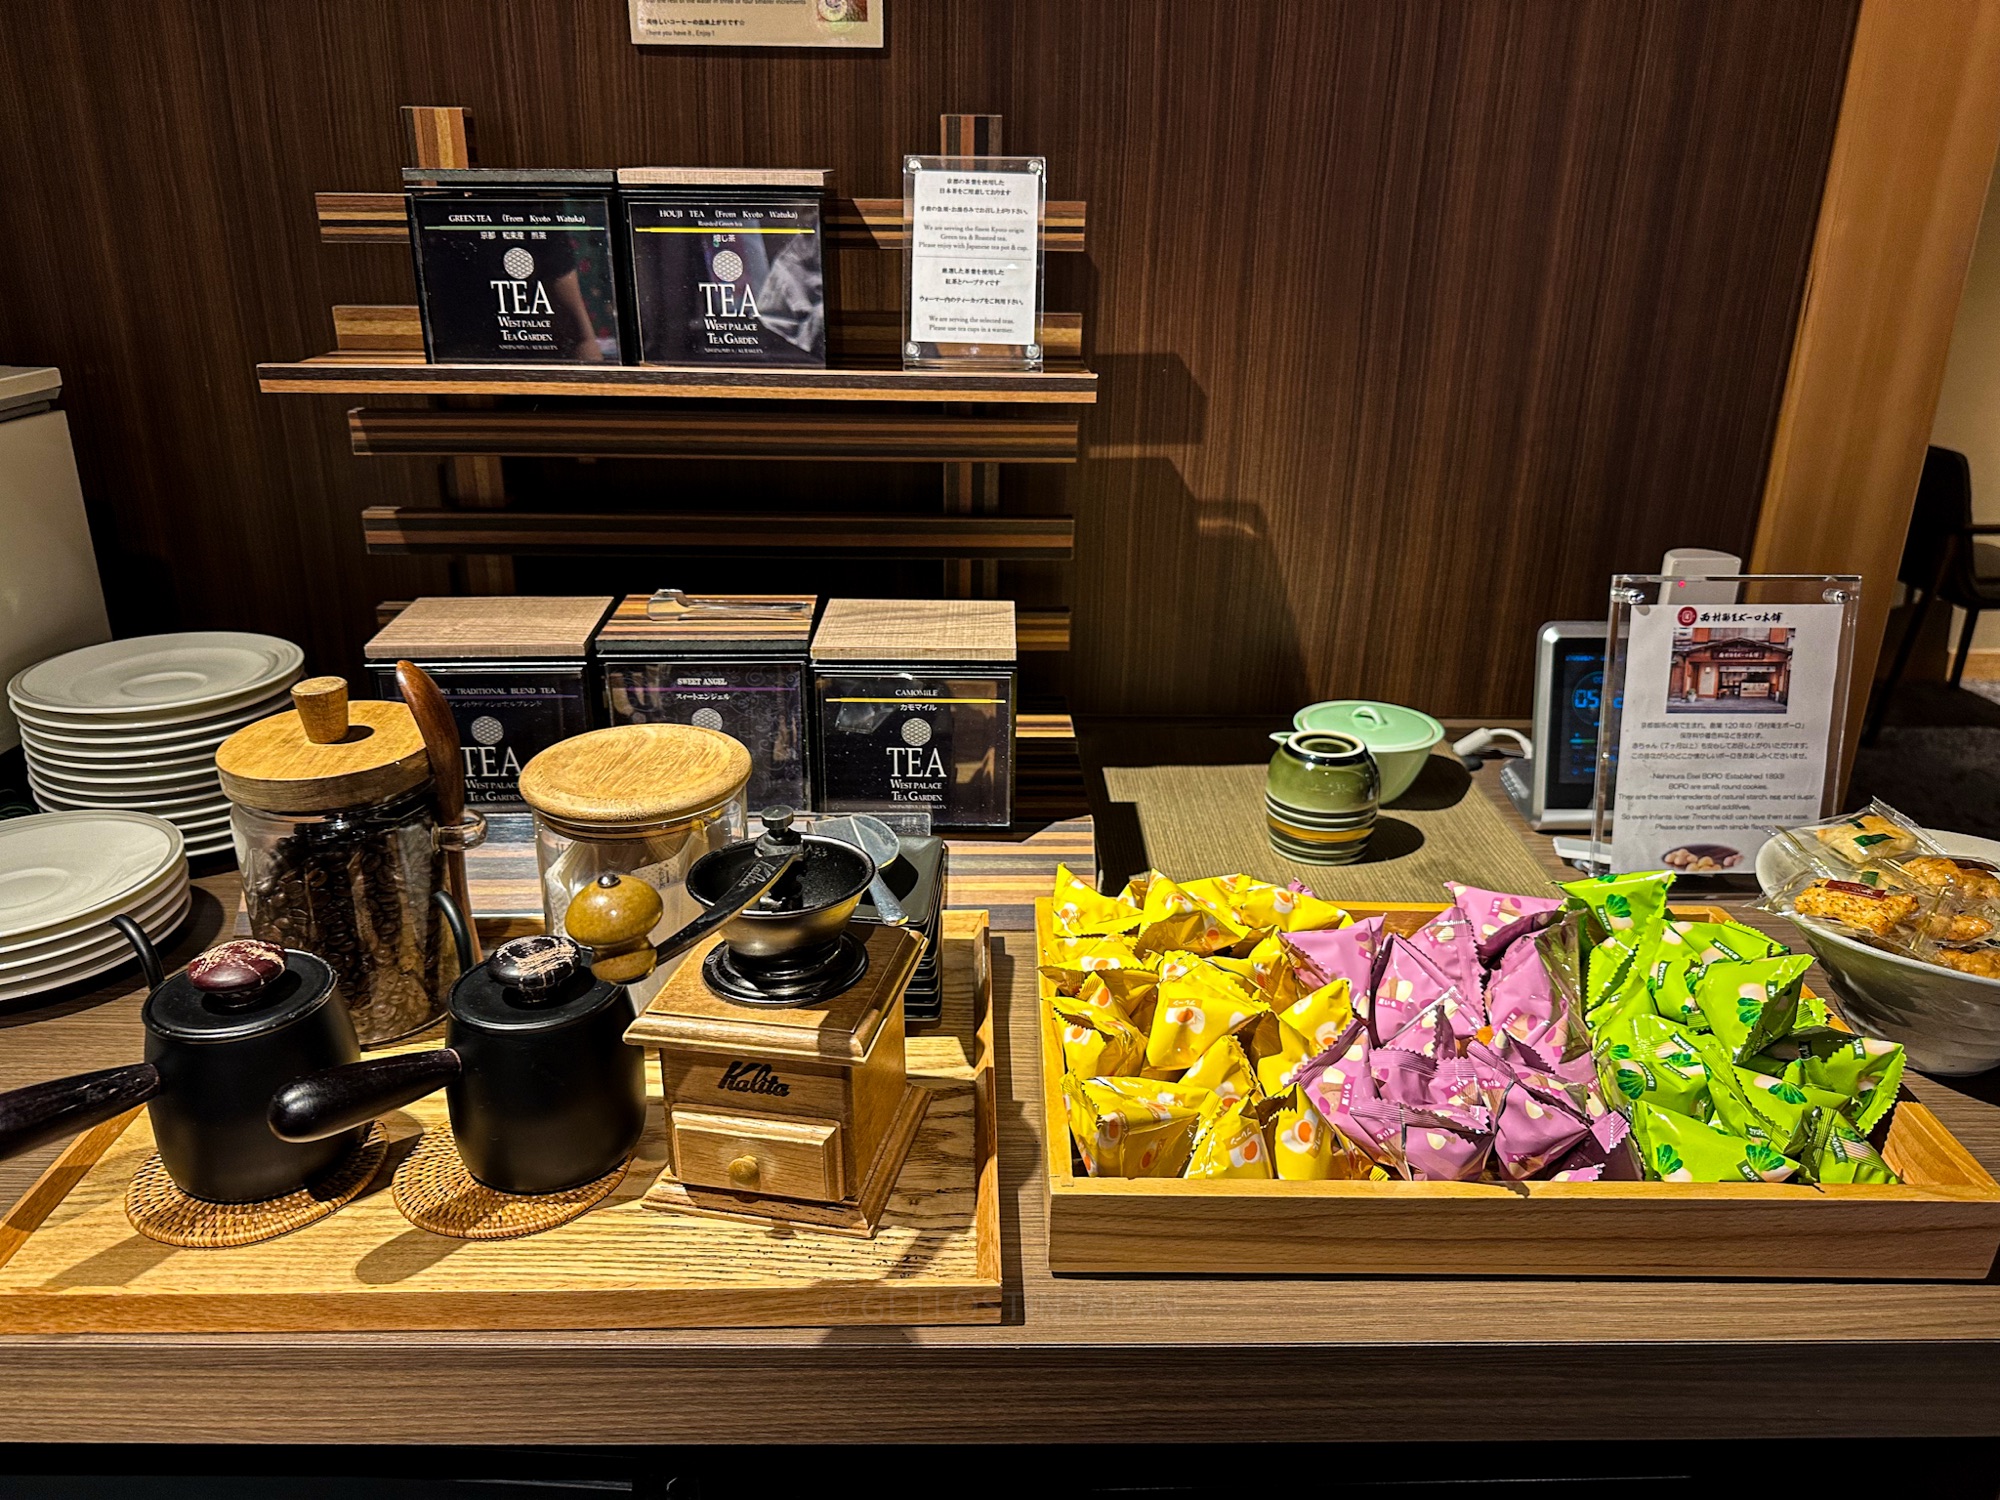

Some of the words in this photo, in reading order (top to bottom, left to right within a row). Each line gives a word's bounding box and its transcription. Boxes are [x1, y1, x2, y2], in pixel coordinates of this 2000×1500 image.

[502, 214, 524, 223] (From
[530, 215, 552, 224] Kyoto
[557, 215, 586, 224] Watuka)
[659, 210, 683, 218] HOUJI
[688, 210, 705, 218] TEA
[715, 210, 737, 218] (From
[742, 210, 764, 220] Kyoto
[769, 211, 798, 220] Watuka)
[991, 226, 1007, 234] Kyoto
[490, 280, 555, 315] TEA
[698, 283, 762, 318] TEA
[677, 678, 702, 686] SWEET
[702, 678, 728, 686] ANGEL
[900, 704, 937, 712] カモマイル
[460, 746, 521, 778] TEA
[886, 747, 947, 778] TEA
[738, 861, 777, 888] Kalita
[718, 1060, 790, 1098] Kalita
